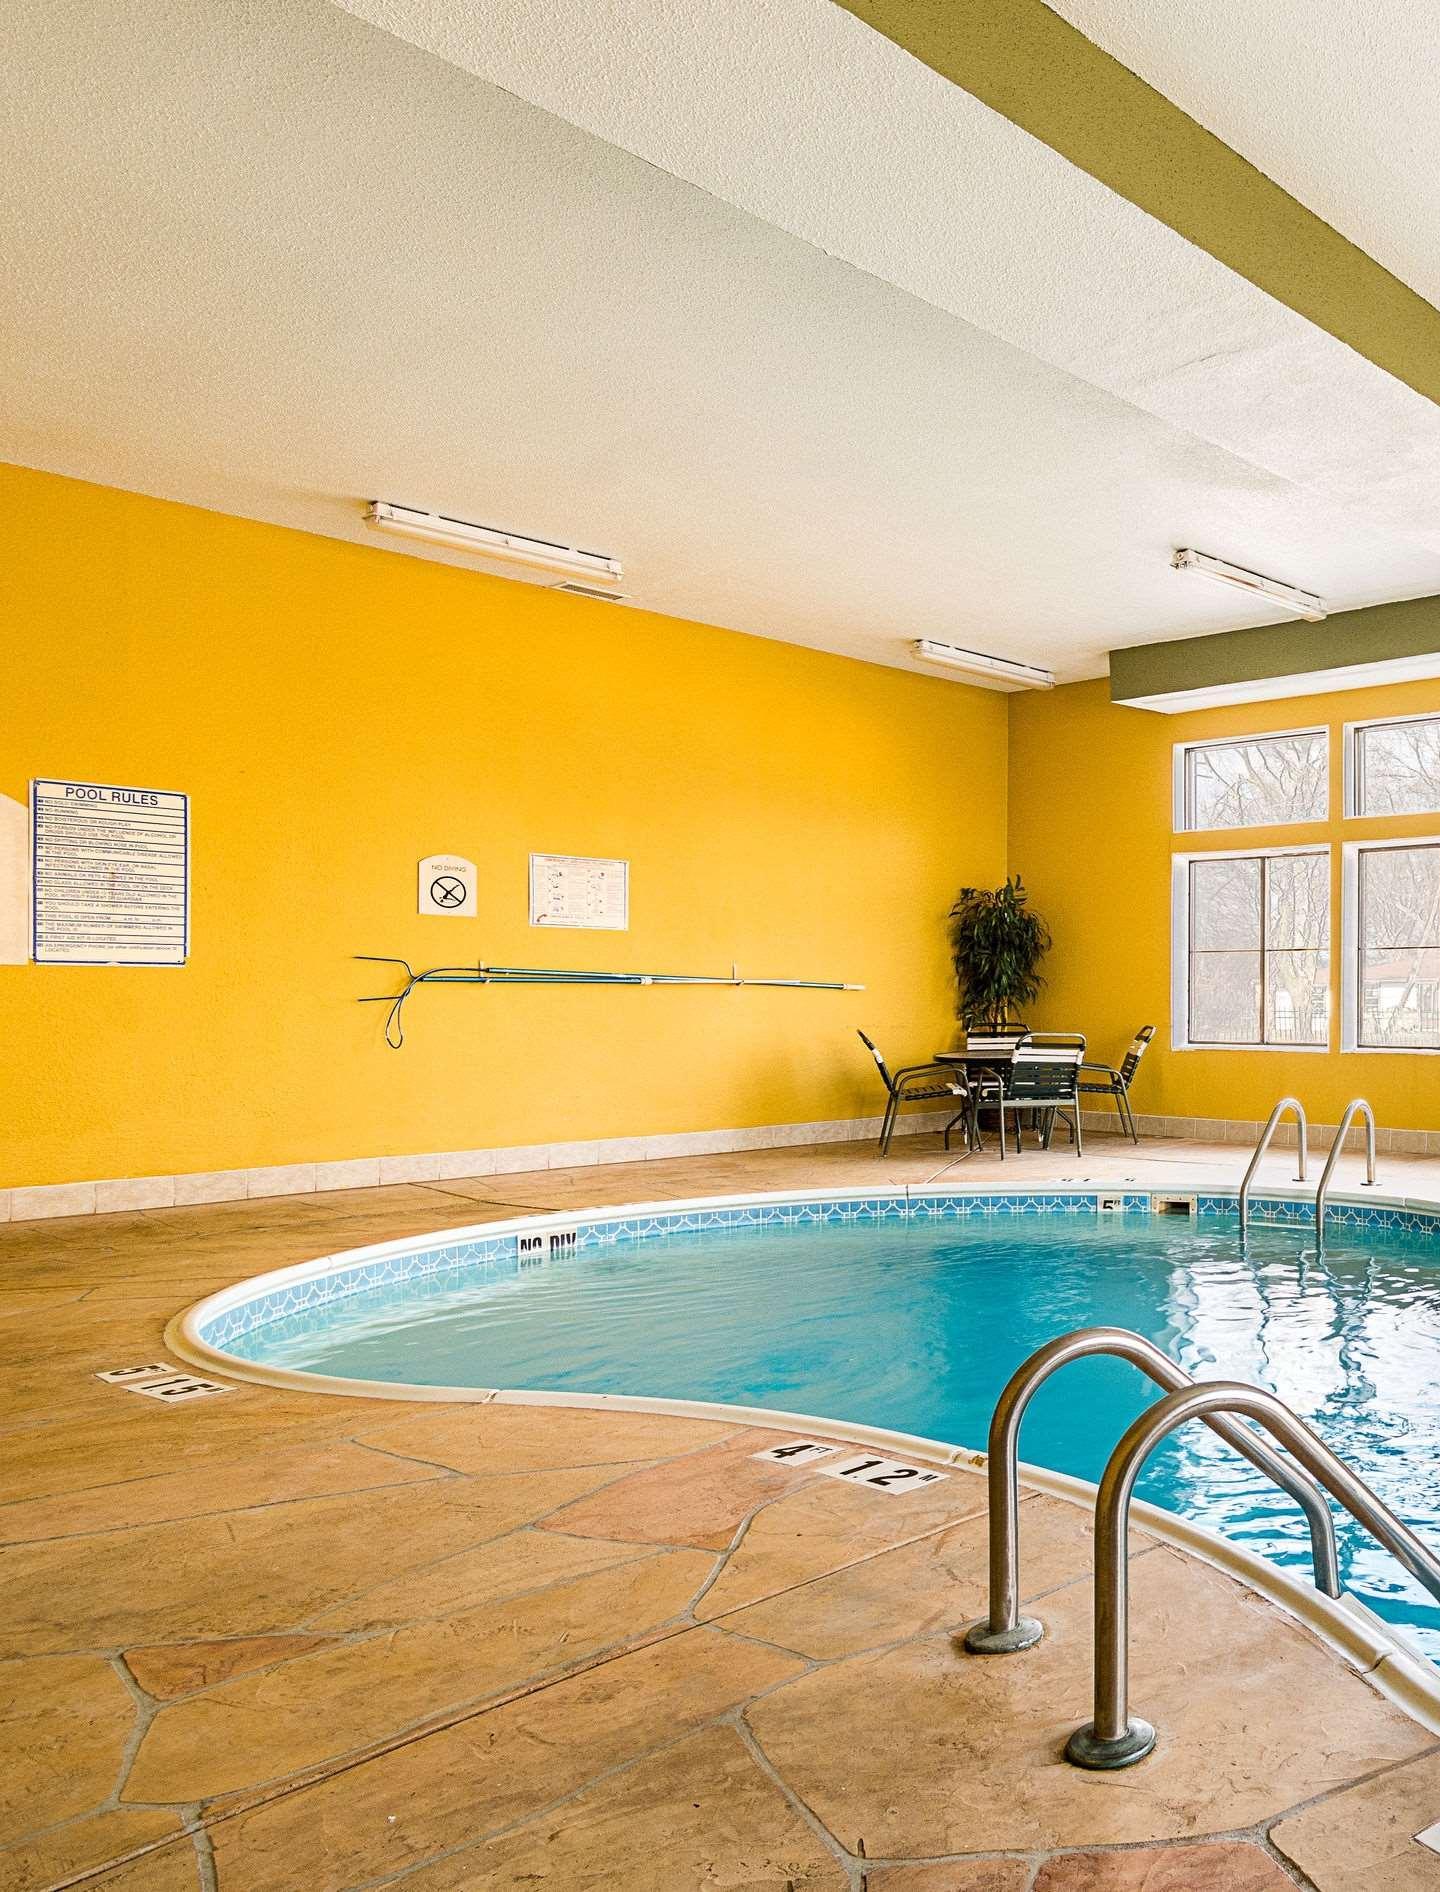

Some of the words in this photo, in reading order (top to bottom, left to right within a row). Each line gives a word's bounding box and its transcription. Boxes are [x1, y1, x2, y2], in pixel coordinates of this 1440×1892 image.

[66, 787, 107, 801] POOL
[112, 792, 158, 806] RULES
[1102, 1200, 1113, 1210] 5
[110, 1364, 162, 1376] 5
[770, 1444, 816, 1458] 4
[809, 1446, 833, 1454] FT
[840, 1460, 920, 1486] 1.2
